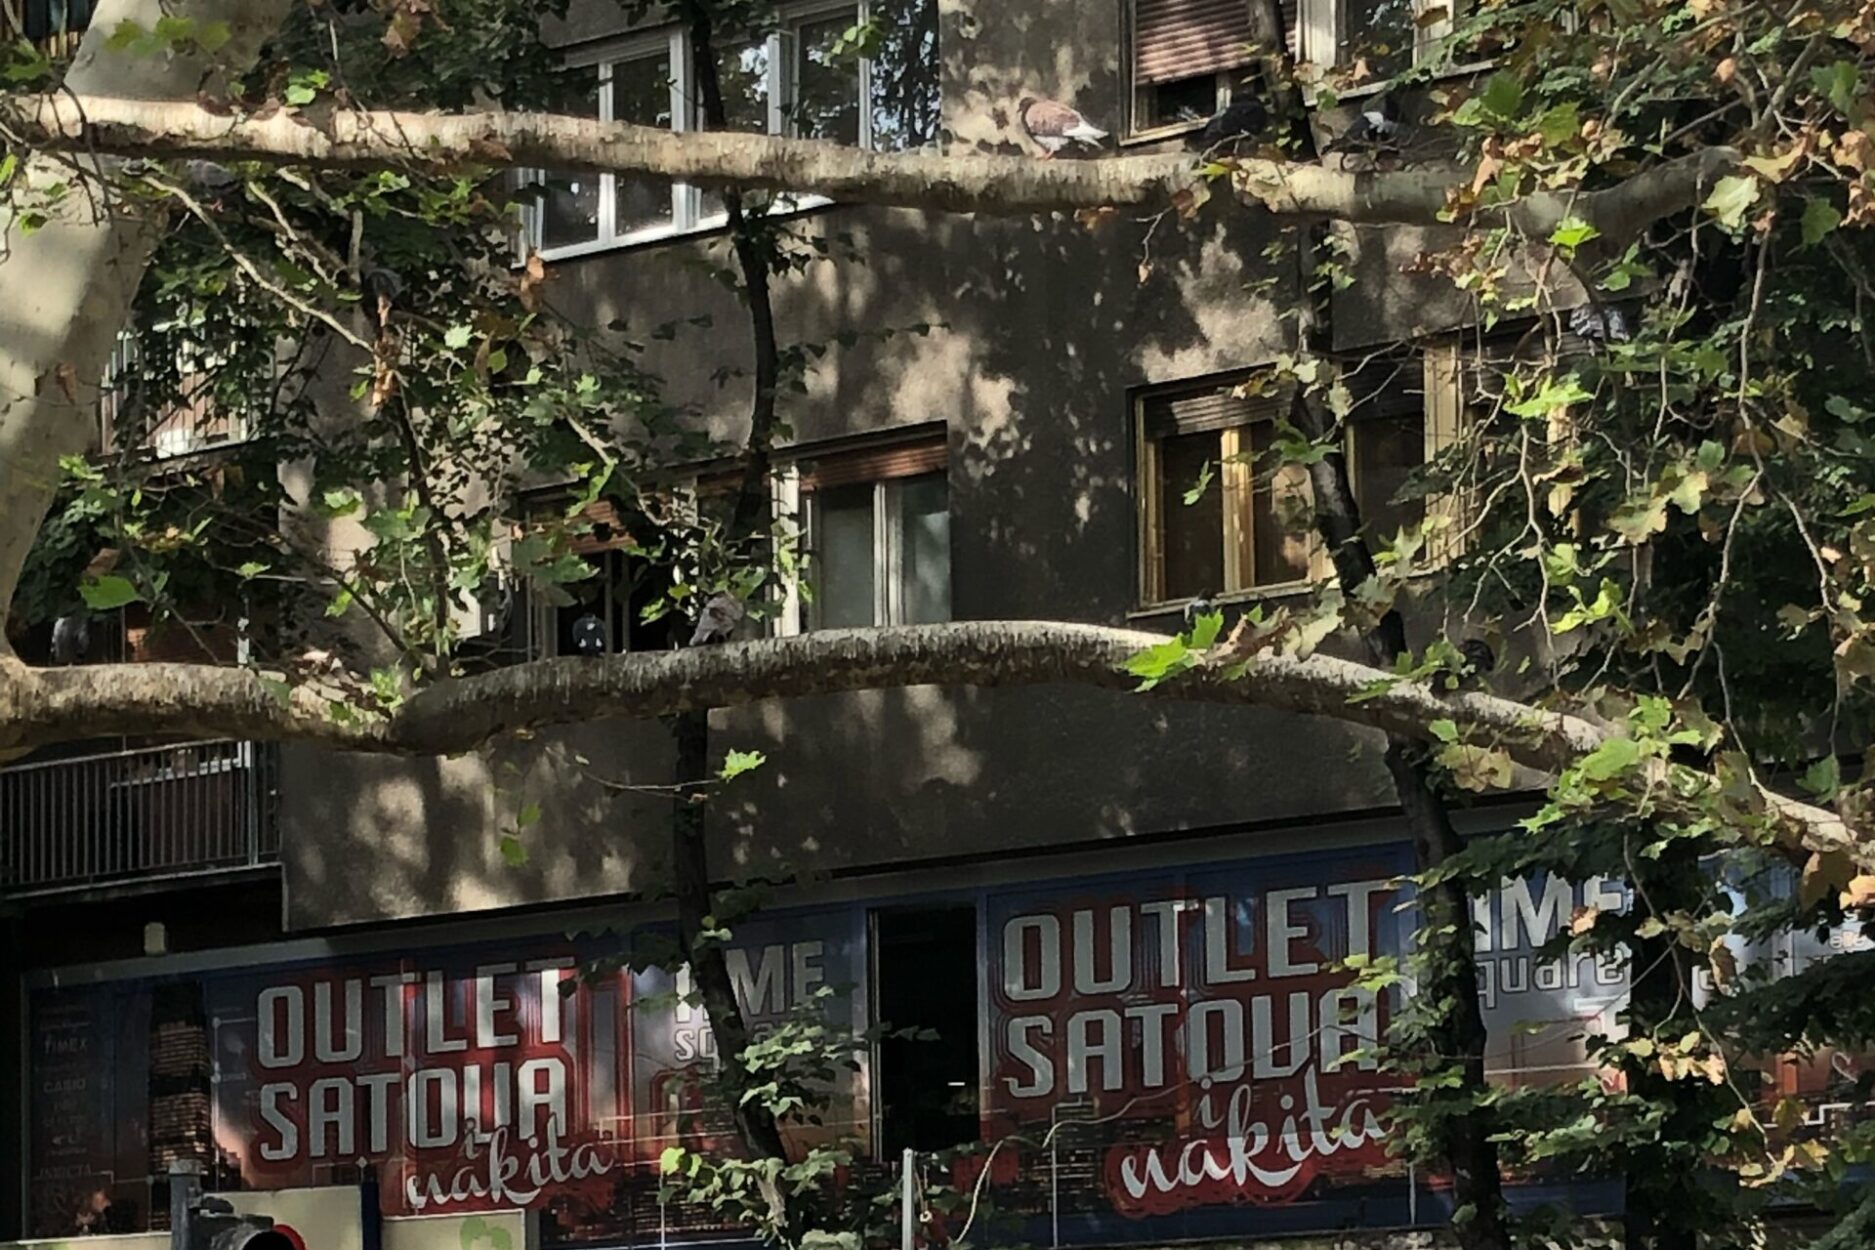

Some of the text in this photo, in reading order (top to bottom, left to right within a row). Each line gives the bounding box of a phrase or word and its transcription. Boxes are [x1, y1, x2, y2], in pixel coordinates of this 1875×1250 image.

[1003, 879, 1394, 1002] OUTLET
[257, 957, 575, 1069] OUTLET
[406, 1111, 614, 1208] nakita
[1120, 1064, 1389, 1200] nakita
